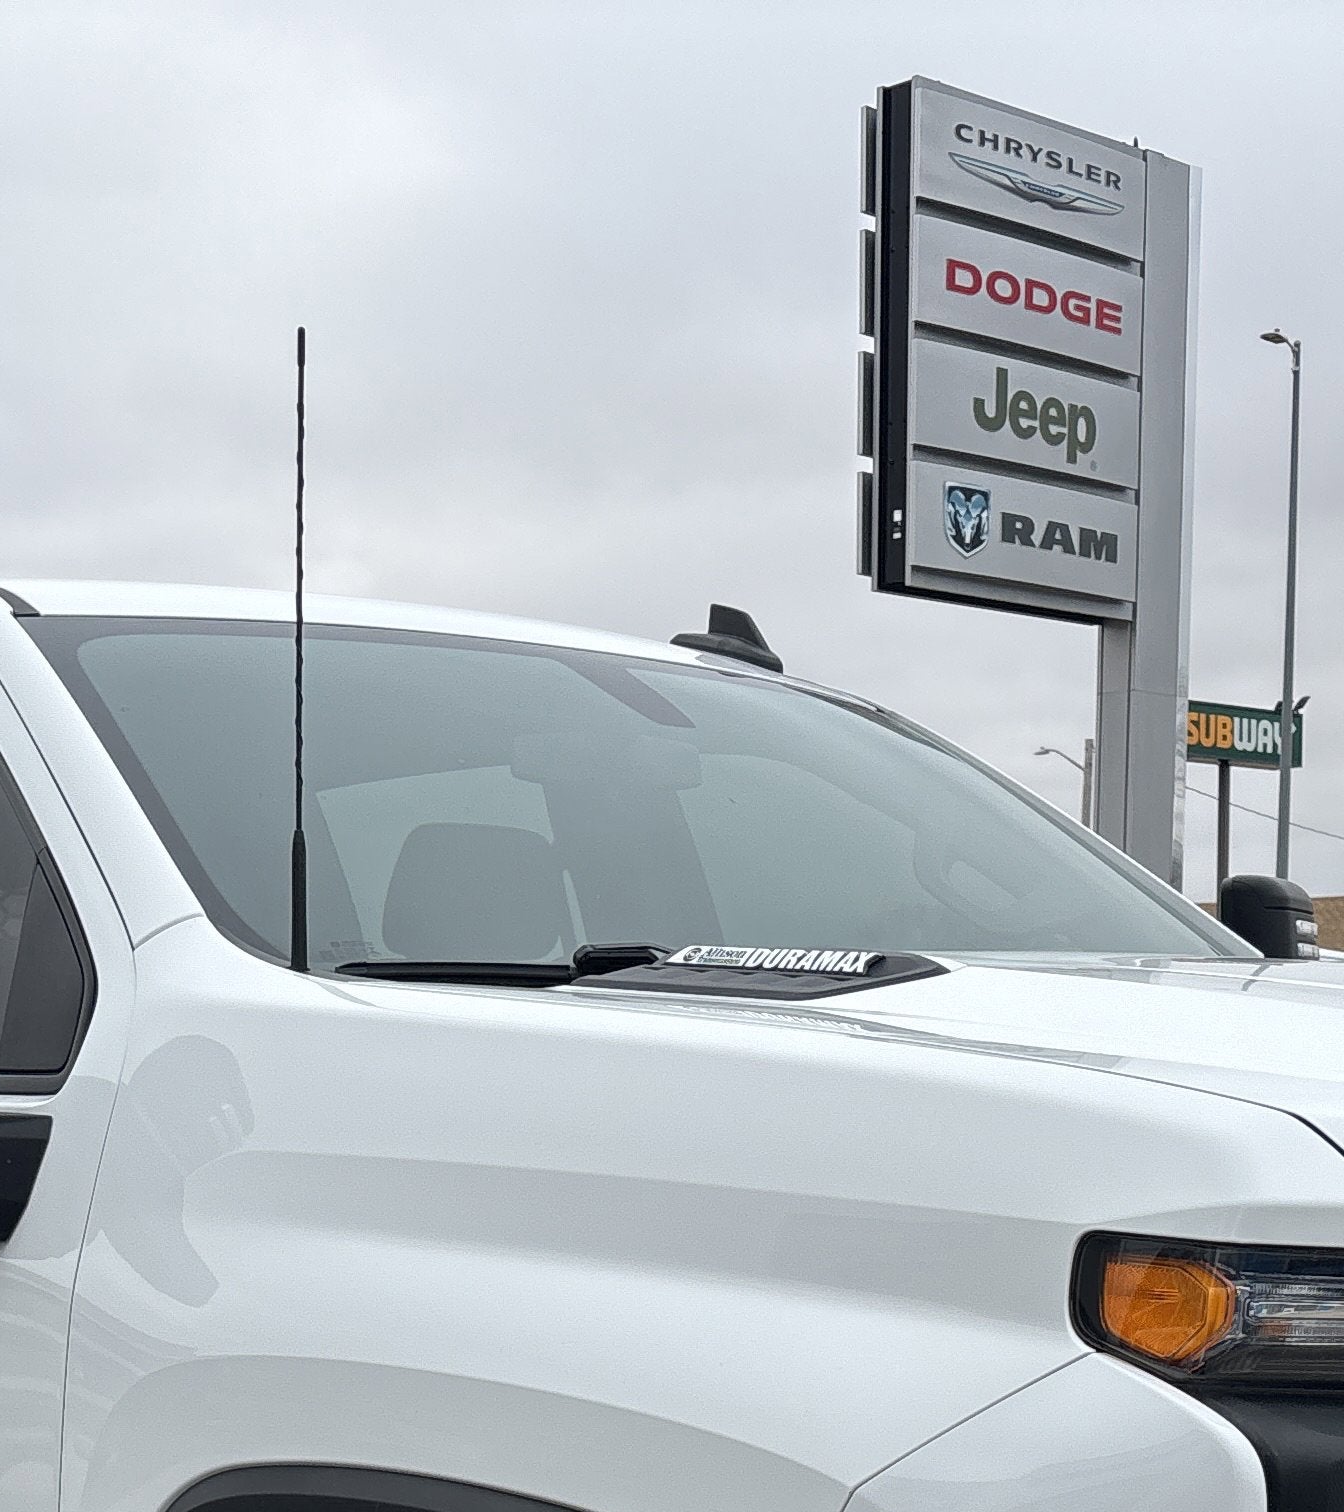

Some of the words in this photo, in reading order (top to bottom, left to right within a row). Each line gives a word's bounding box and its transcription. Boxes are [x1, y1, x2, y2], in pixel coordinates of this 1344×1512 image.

[955, 123, 1123, 191] CHRYSLER
[946, 258, 1123, 336] DODGE
[973, 366, 1097, 465] Jeep
[1001, 511, 1118, 564] RAM
[1187, 712, 1296, 755] SUBWAY
[744, 948, 878, 973] DURAMAX
